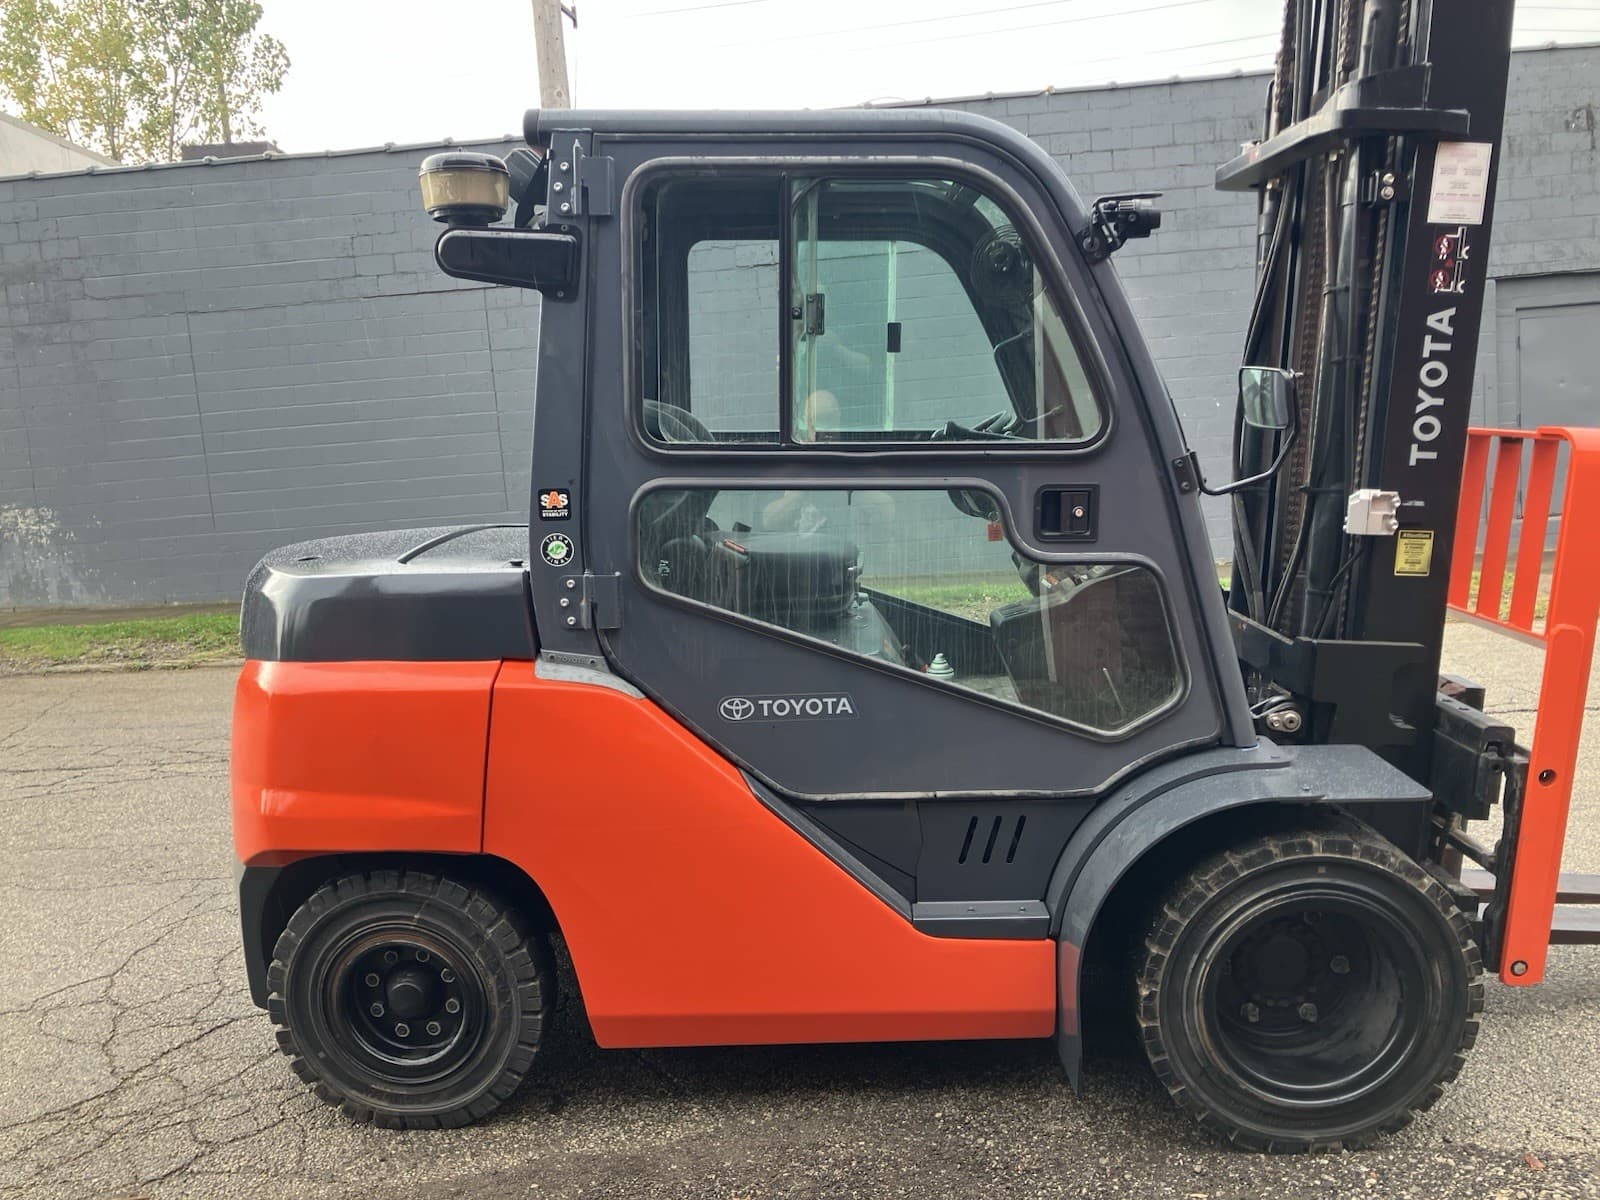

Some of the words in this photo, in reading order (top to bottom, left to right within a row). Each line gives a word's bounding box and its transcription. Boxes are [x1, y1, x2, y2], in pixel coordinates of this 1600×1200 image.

[1409, 307, 1457, 467] TOYOTA
[540, 491, 569, 509] SAS
[546, 556, 570, 565] FINAL
[758, 697, 853, 716] TOYOTA
